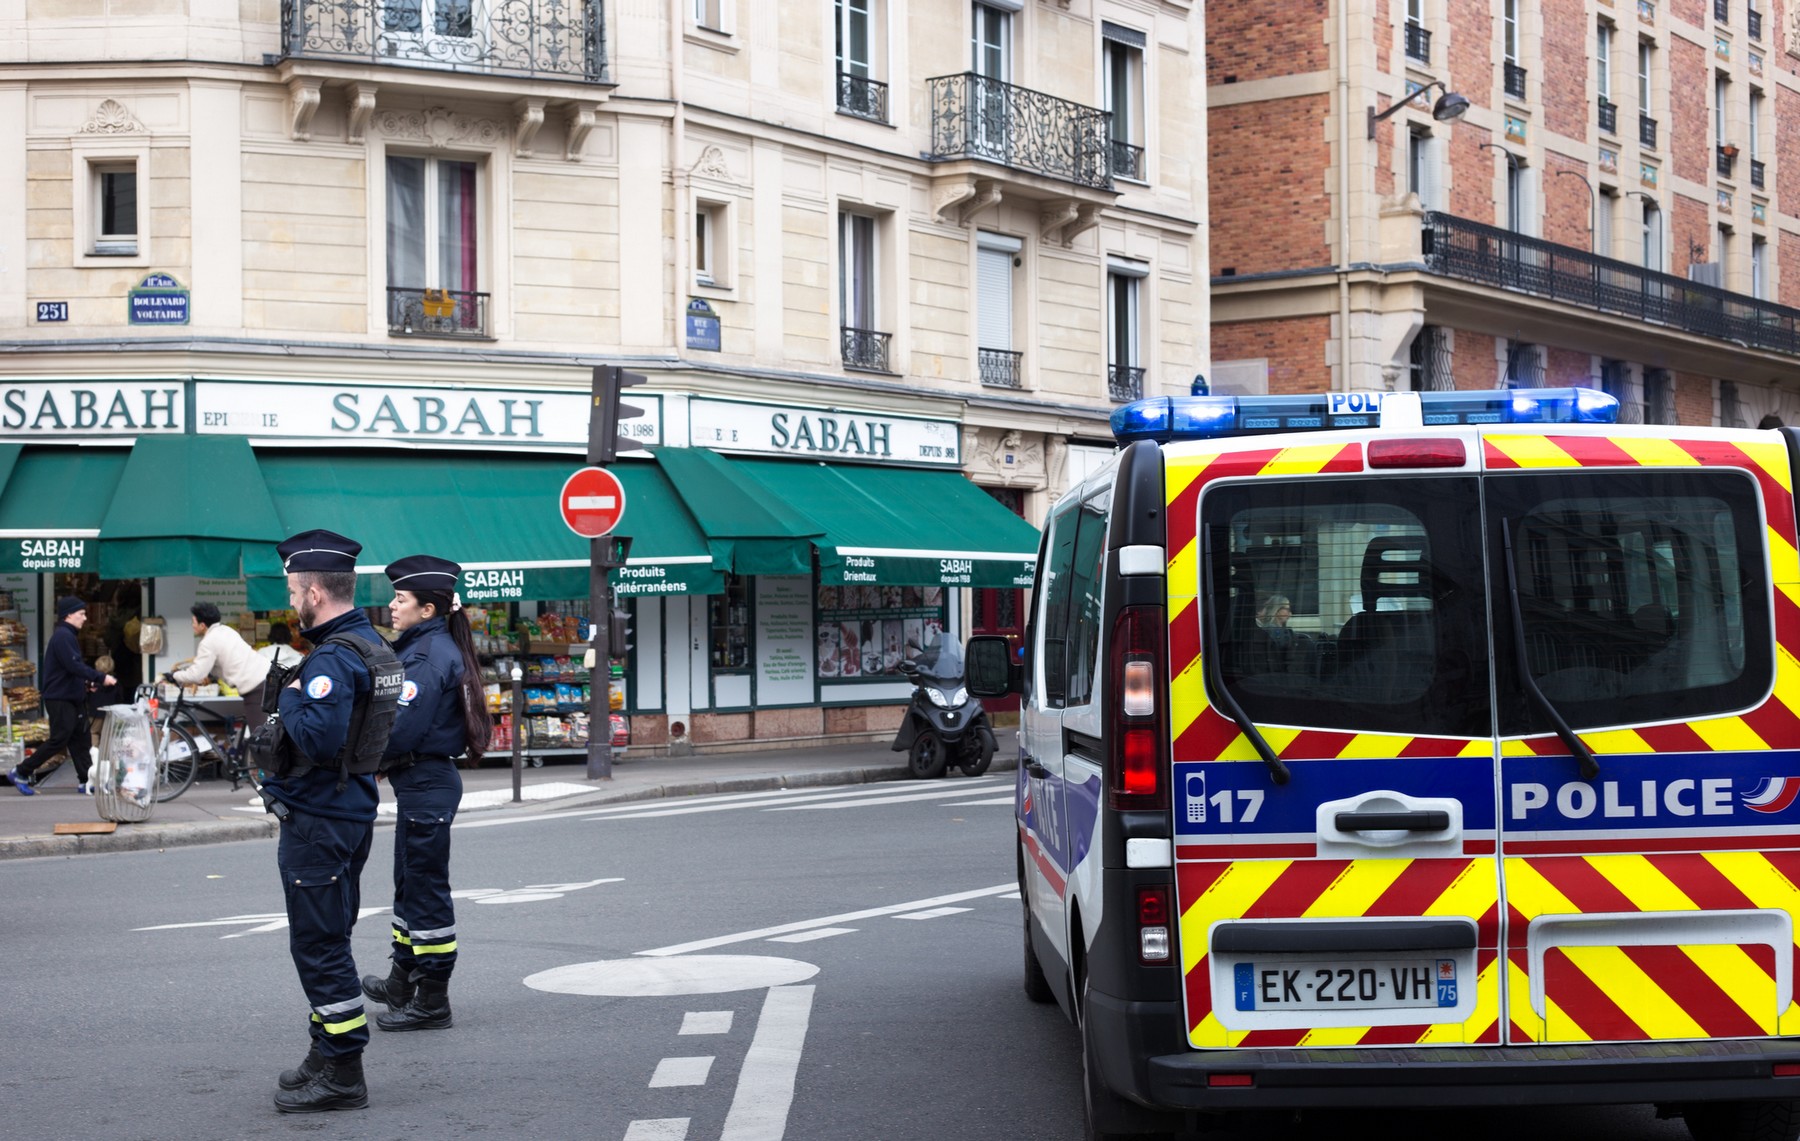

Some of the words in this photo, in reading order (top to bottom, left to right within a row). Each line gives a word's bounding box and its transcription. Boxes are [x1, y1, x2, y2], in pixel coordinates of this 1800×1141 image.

[134, 298, 186, 306] BOULEVARD
[38, 304, 66, 320] 251
[136, 310, 184, 318] VOLTAIRE
[3, 389, 178, 430] SABAH
[332, 393, 544, 436] SABAH
[633, 424, 654, 437] 1988
[772, 413, 892, 456] SABAH
[920, 446, 942, 457] DEPUIS
[21, 540, 84, 556] SABAH
[22, 558, 56, 570] depuis
[58, 558, 82, 568] 1988
[846, 556, 874, 568] Produits
[940, 560, 972, 574] SABAH
[464, 570, 524, 587] SABAH
[620, 566, 666, 578] Produits
[844, 570, 876, 582] Orientaux
[940, 574, 959, 584] depuis
[467, 589, 499, 600] depuis
[501, 587, 522, 597] 1988
[612, 580, 687, 594] ditérranéens
[376, 674, 402, 688] POLICE
[1209, 790, 1264, 822] 17
[1511, 778, 1734, 820] POLICE
[1261, 968, 1431, 1002] EK-220-VH
[1438, 984, 1456, 1000] 75
[1242, 992, 1248, 1001] F
